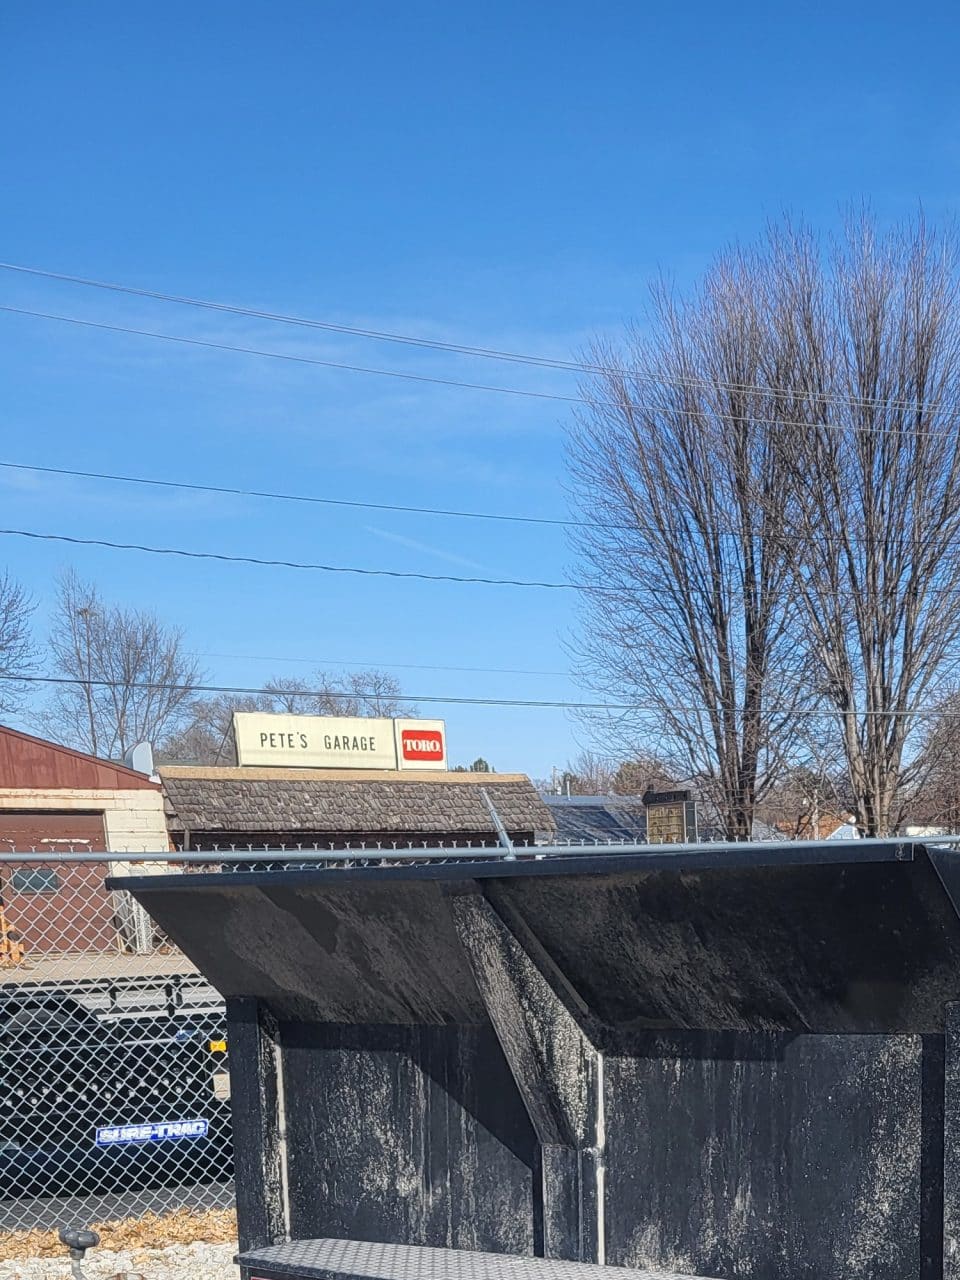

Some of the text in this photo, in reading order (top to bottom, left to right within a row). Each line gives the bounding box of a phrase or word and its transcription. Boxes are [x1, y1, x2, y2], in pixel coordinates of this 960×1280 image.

[260, 732, 376, 751] PETE'S GARAGE
[100, 1122, 205, 1143] SURE-TRAC
